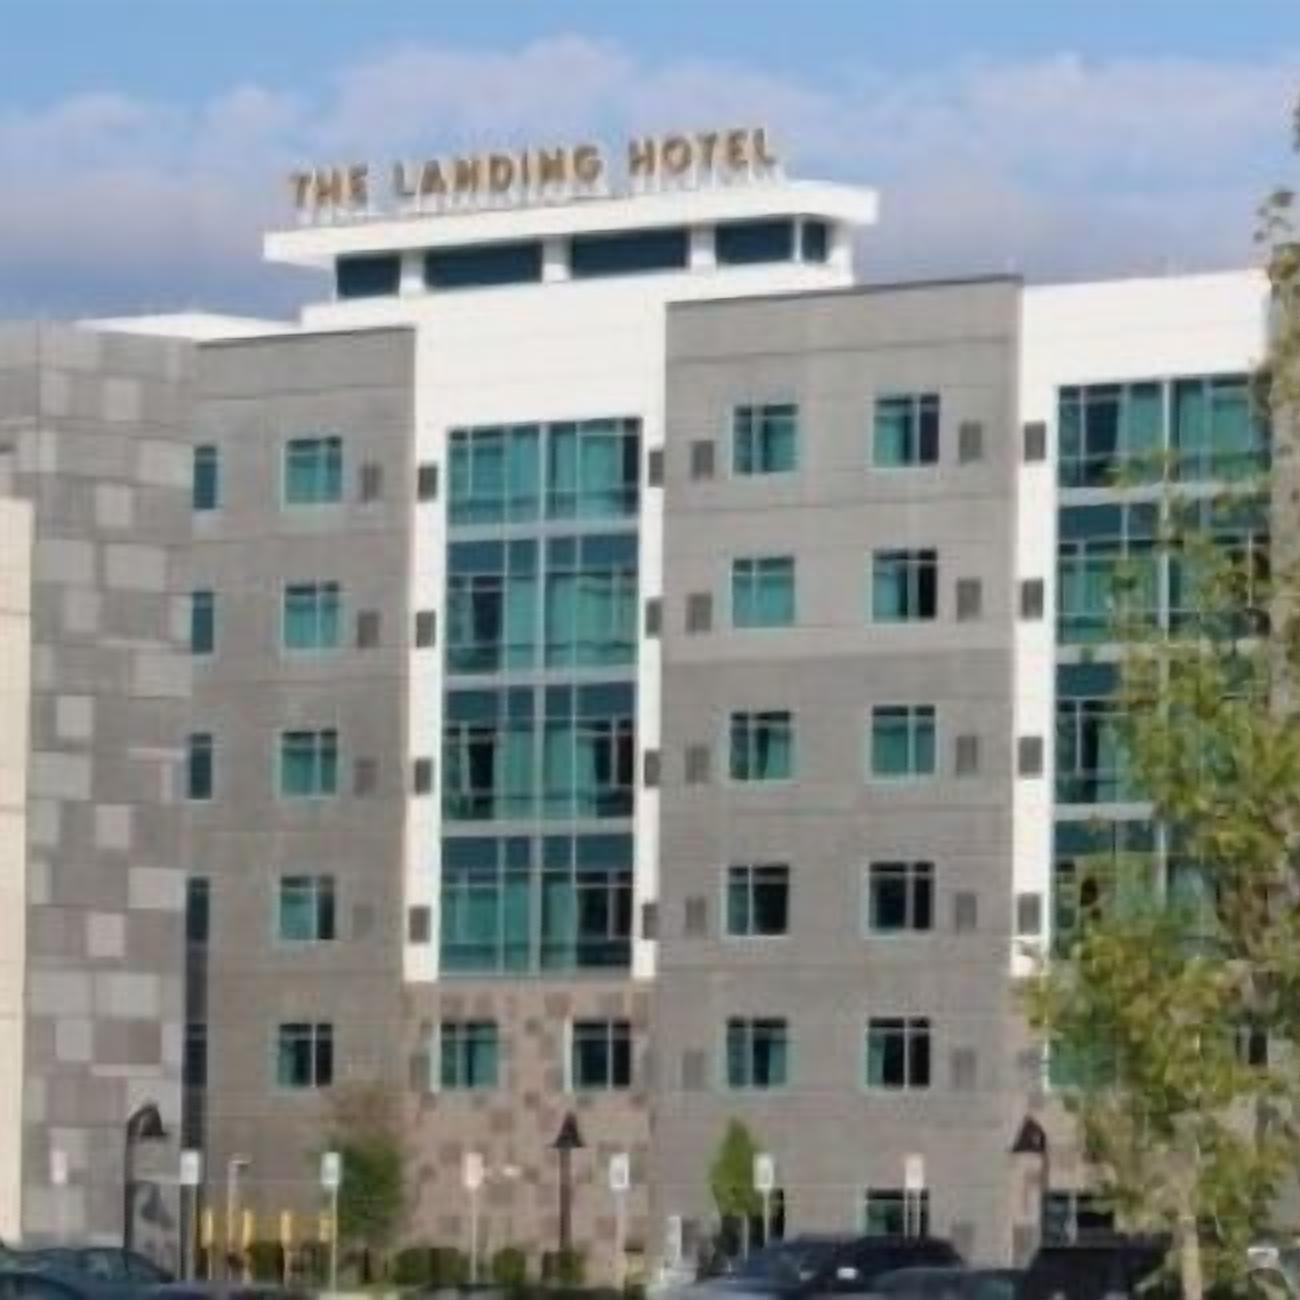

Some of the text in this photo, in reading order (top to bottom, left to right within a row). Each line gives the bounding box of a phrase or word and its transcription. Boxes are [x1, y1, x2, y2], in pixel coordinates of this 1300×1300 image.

[289, 128, 777, 207] THE LANDING HOTEL
